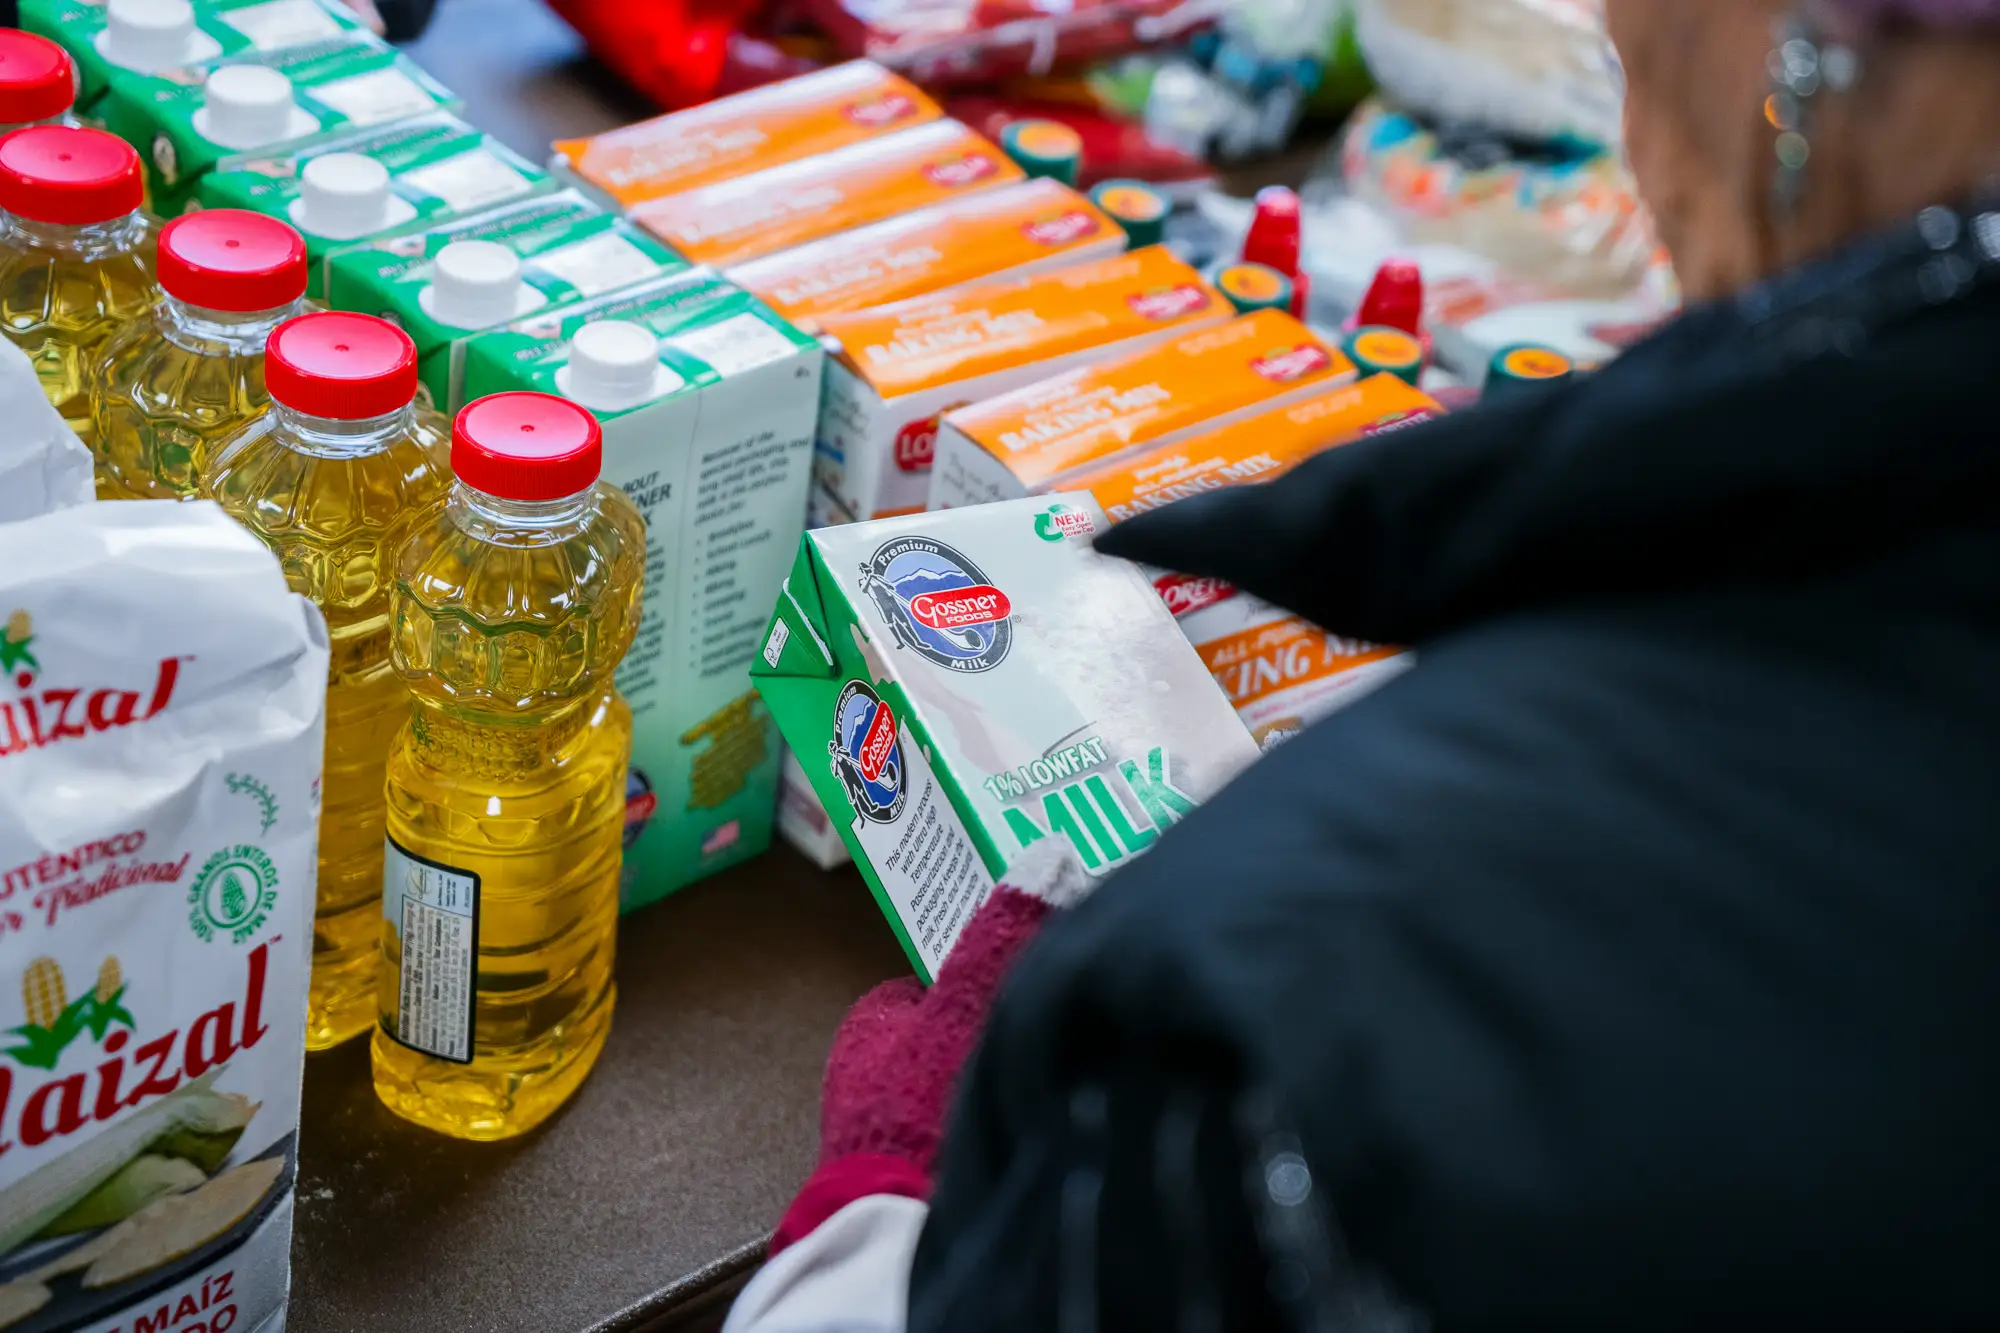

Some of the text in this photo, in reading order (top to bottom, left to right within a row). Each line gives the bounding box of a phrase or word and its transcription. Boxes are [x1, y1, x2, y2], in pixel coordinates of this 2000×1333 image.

[999, 404, 1105, 453] BAKING
[1109, 382, 1172, 412] MIX
[1055, 511, 1090, 527] NEW!
[1107, 472, 1224, 523] BAKING
[1219, 452, 1283, 482] MIX
[877, 540, 938, 567] Premium
[1064, 529, 1082, 537] Screw
[914, 593, 997, 628] Gossner
[945, 611, 993, 624] FOODS
[950, 657, 990, 670] Milk
[835, 685, 857, 734] Premium
[861, 710, 892, 777] Gossner
[876, 732, 894, 766] FOODS
[984, 735, 1110, 802] 1% LOWFAT
[885, 778, 933, 872] This modern process
[890, 791, 905, 819] Milk
[1001, 746, 1198, 873] MILK
[901, 804, 938, 875] with Ultra High
[910, 823, 944, 884] Temperature
[910, 823, 955, 913] Pasteurization and
[33, 852, 190, 927] Tradicional
[233, 843, 279, 888] ENTEROS
[261, 890, 278, 911] DE
[916, 883, 945, 933] packaging
[942, 855, 959, 887] keeps
[921, 924, 936, 950] milk
[933, 900, 950, 933] fresh
[948, 881, 959, 904] and
[932, 937, 944, 960] for
[942, 903, 963, 941] several
[0, 943, 269, 1157] aizal
[134, 1270, 234, 1333] MAÍZ
